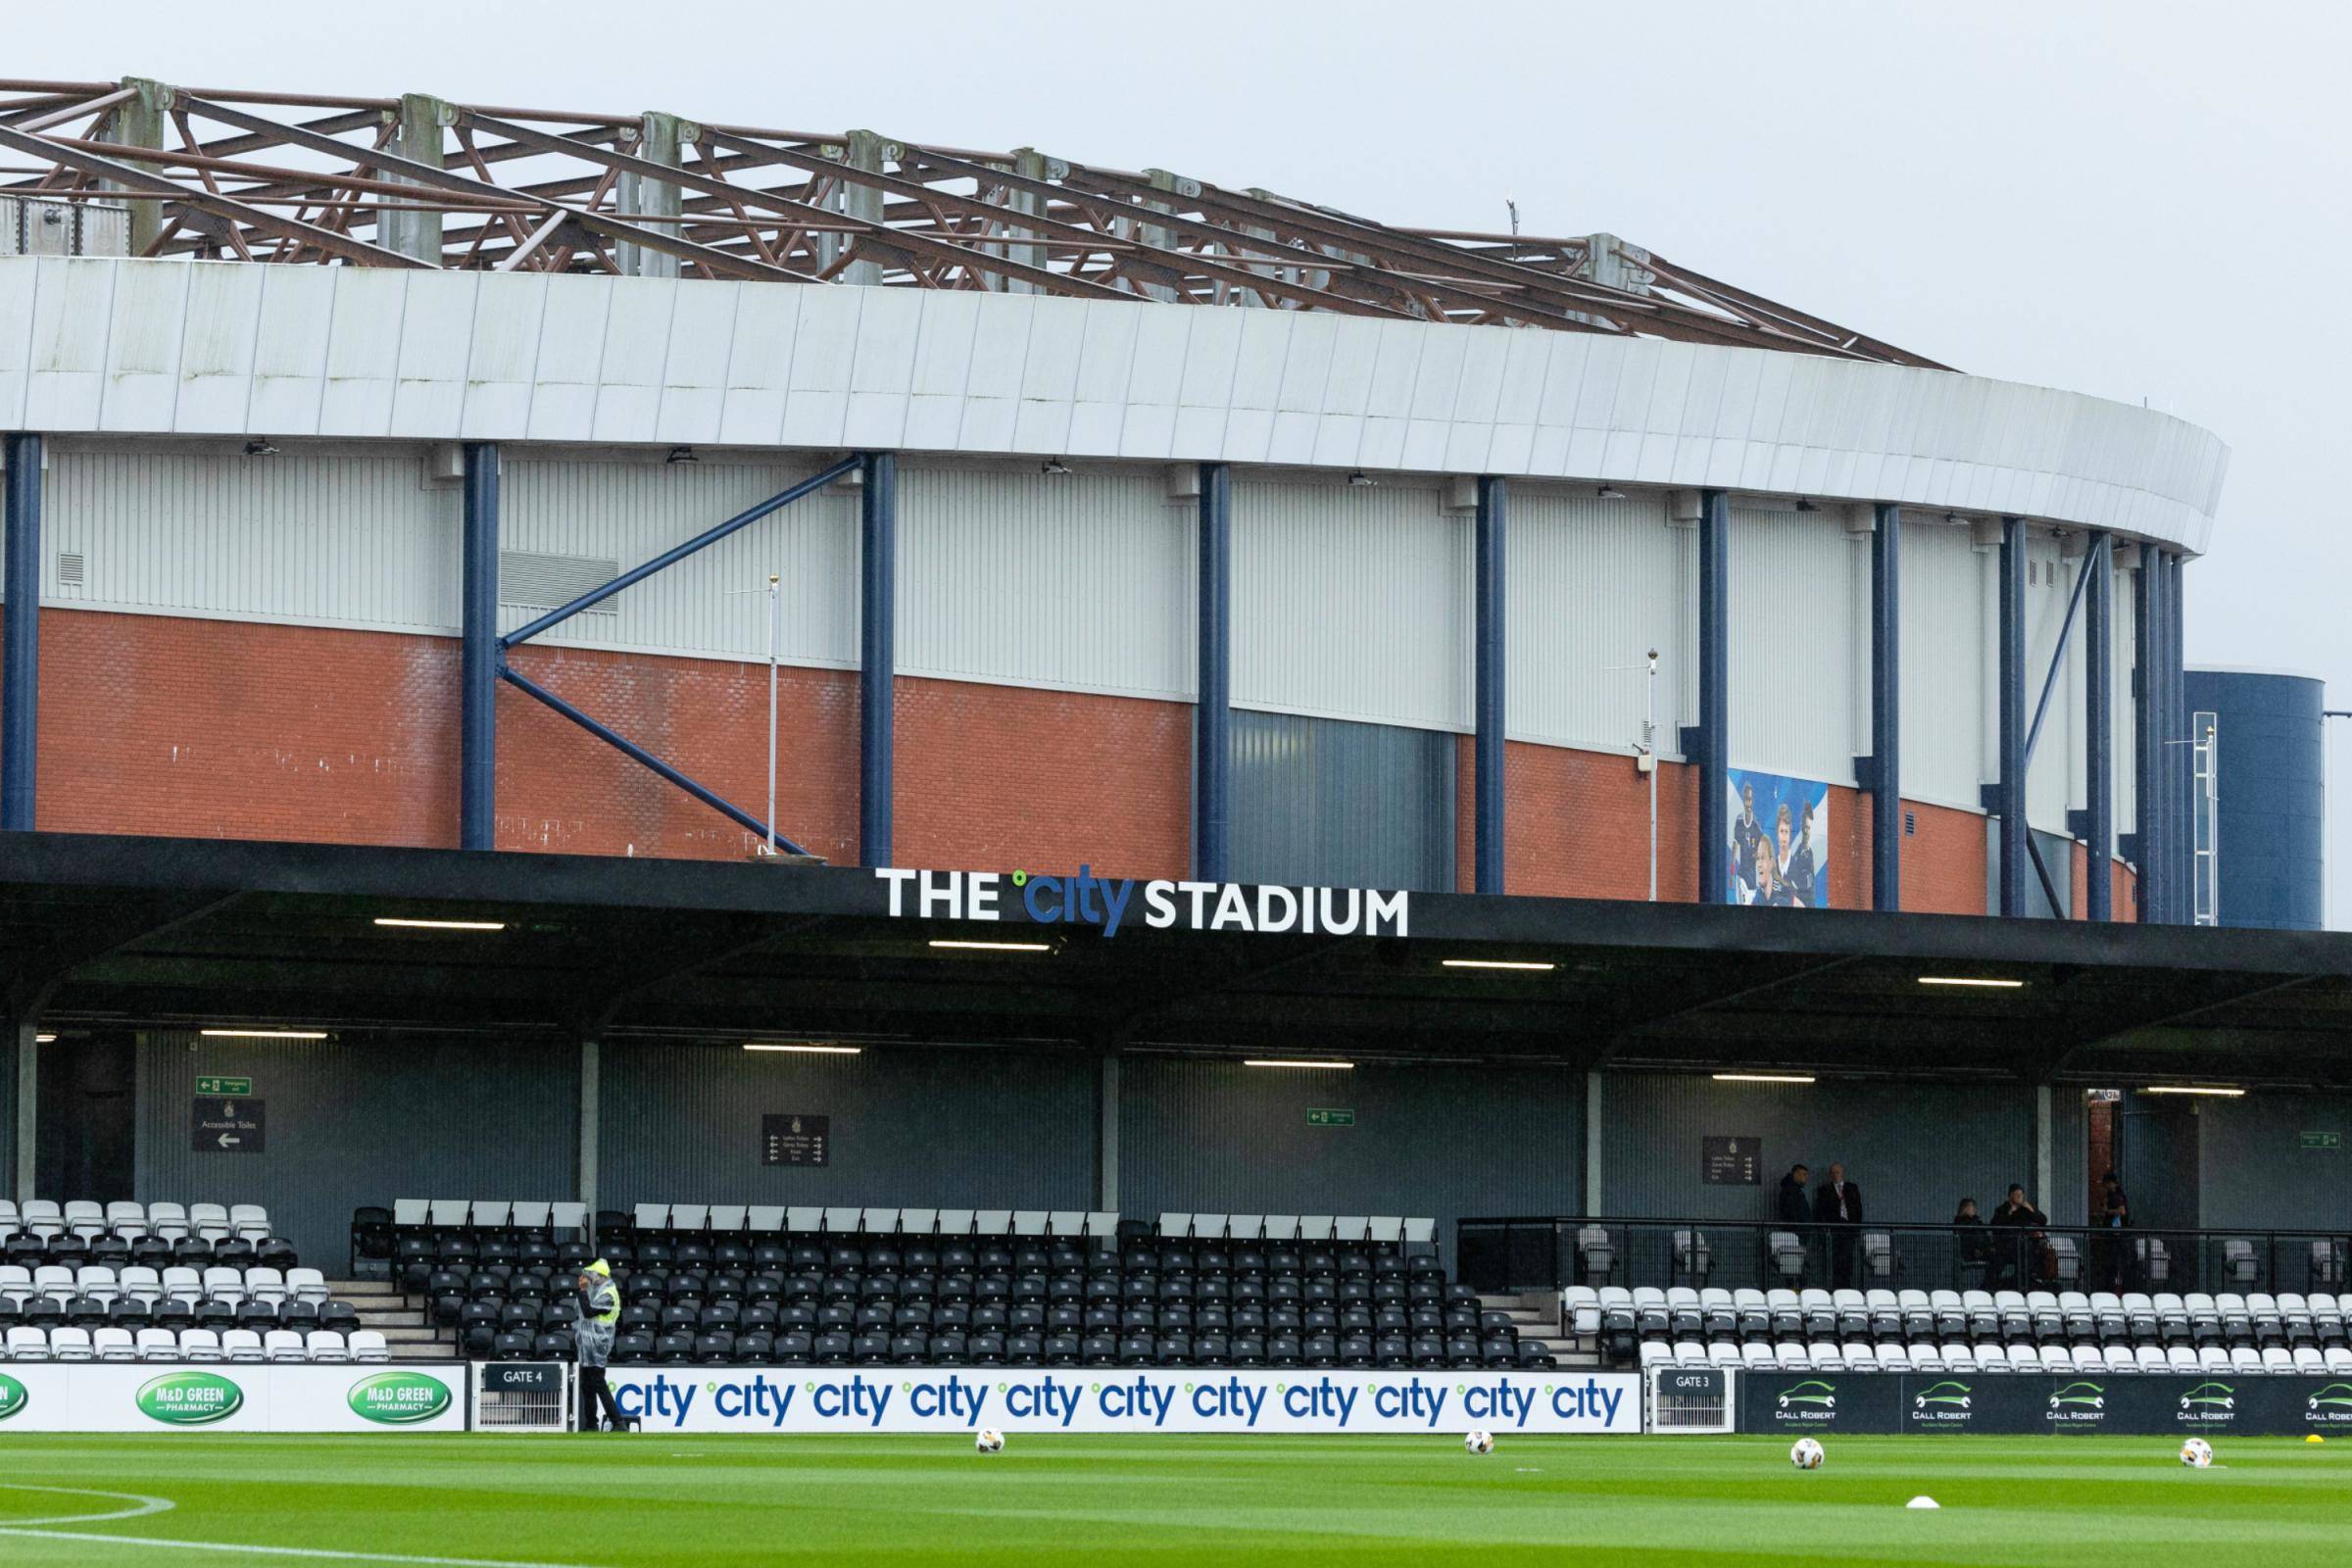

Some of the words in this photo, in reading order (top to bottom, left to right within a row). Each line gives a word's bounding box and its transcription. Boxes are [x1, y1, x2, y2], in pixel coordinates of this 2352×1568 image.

[875, 868, 1000, 919] THE
[1145, 880, 1408, 937] STADIUM
[202, 1120, 236, 1129] Accessible
[237, 1121, 257, 1130] Toilet
[503, 1371, 533, 1383] GATE
[535, 1371, 542, 1383] 4
[1676, 1376, 1701, 1387] GATE
[1703, 1376, 1709, 1387] 3
[156, 1387, 184, 1401] M&D
[186, 1387, 224, 1402] GREEN
[367, 1387, 394, 1401] M&D
[397, 1387, 433, 1401] GREEN
[2046, 1411, 2069, 1420] CALL
[2071, 1411, 2105, 1420] ROBERT
